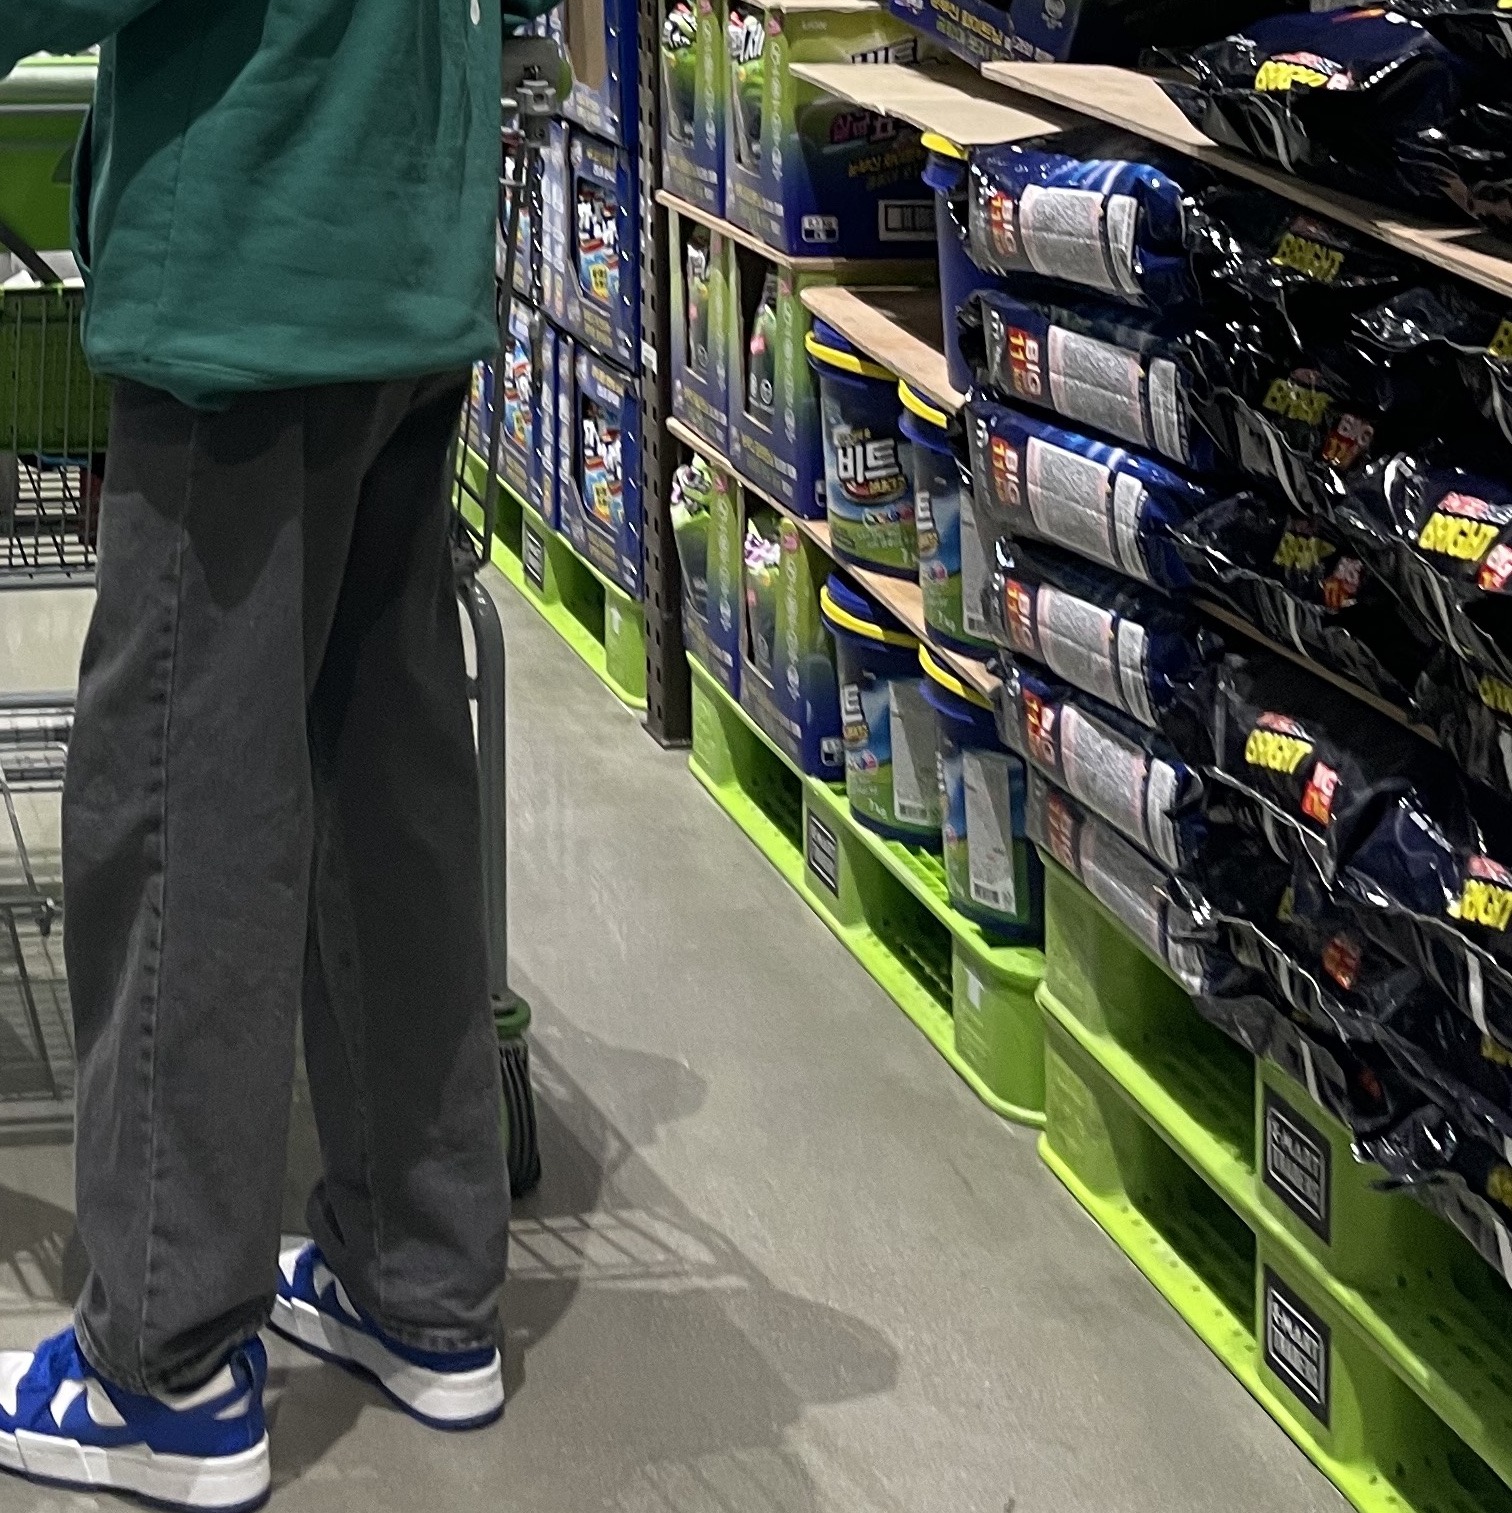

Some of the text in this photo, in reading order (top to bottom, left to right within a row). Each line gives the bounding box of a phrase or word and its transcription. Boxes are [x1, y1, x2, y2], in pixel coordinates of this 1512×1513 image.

[1001, 199, 1018, 254] BIG
[1024, 338, 1042, 396] BIG
[838, 438, 900, 484] 비트
[1004, 448, 1021, 506] BIG
[1018, 592, 1035, 650] BIG
